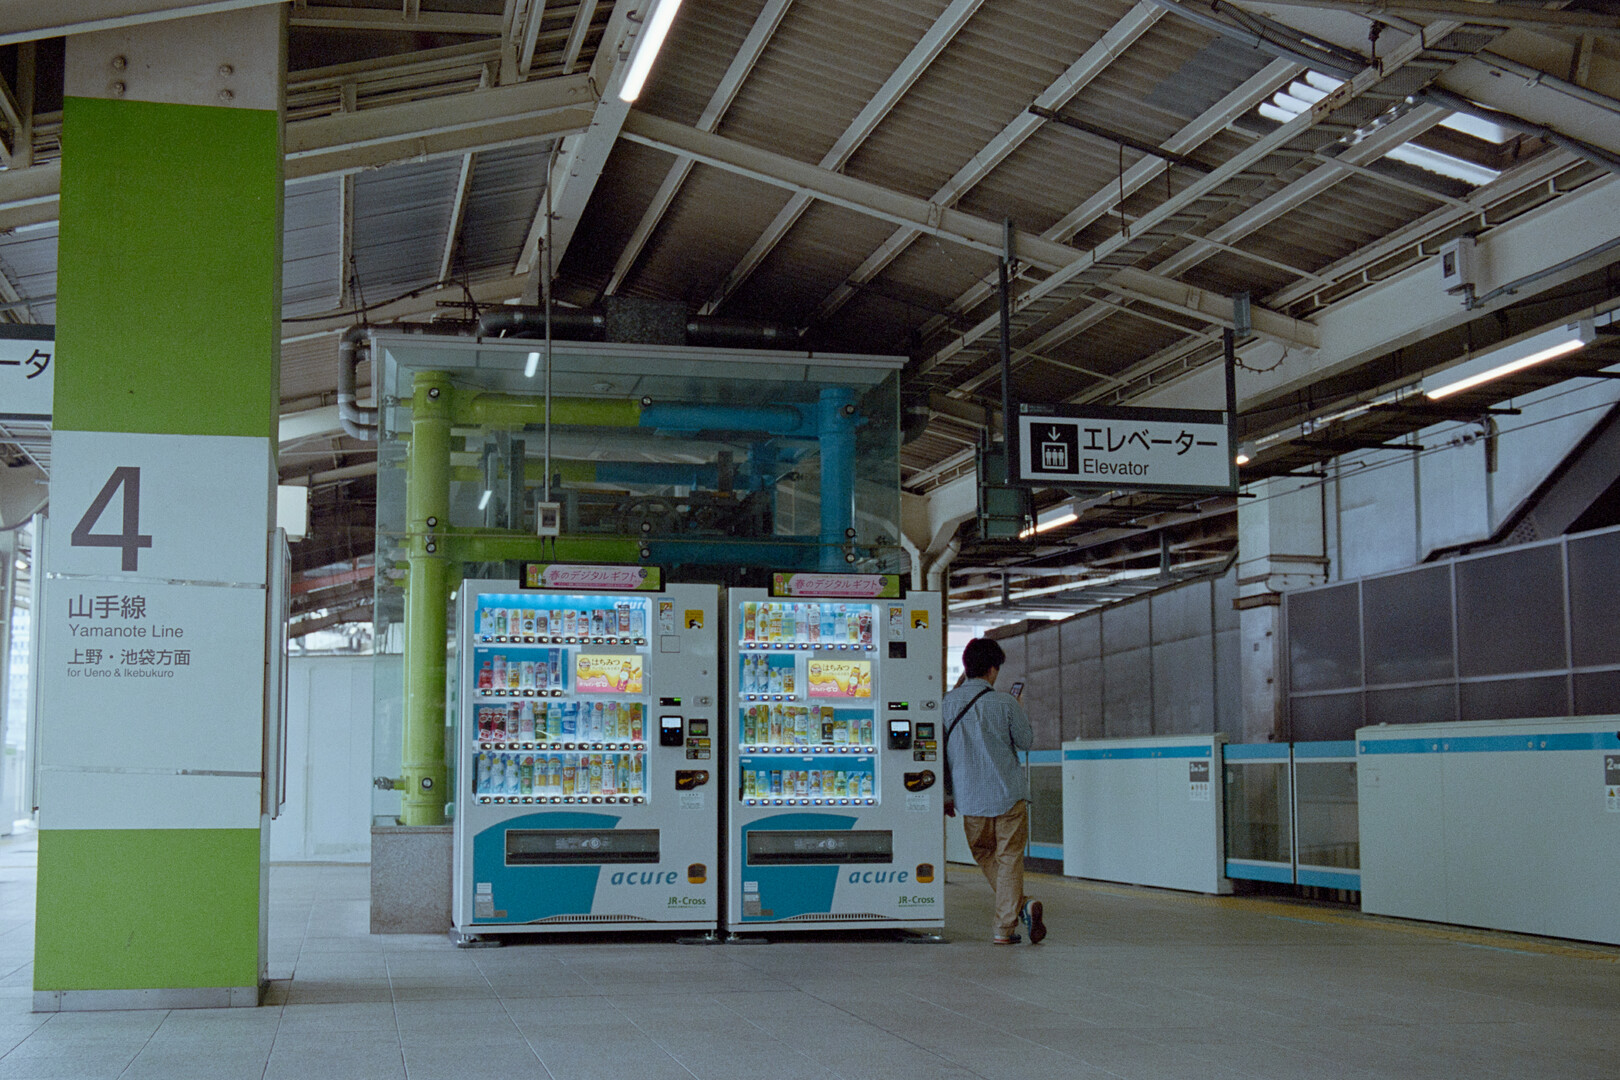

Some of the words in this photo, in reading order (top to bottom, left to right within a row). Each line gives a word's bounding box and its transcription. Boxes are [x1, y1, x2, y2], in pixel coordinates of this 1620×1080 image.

[1083, 427, 1218, 456] エレベーター
[1083, 459, 1149, 476] Elevator
[71, 466, 153, 572] 4
[68, 594, 147, 620] 山手線
[69, 624, 147, 638] Yamanote
[152, 625, 184, 638] Line
[67, 648, 191, 666] 上野・池袋方面
[591, 658, 621, 666] はちみつ
[67, 668, 81, 678] for
[84, 668, 111, 678] Ueno
[113, 669, 121, 678] &
[124, 668, 174, 678] Ikebukuro
[611, 871, 678, 886] acure
[849, 871, 909, 884] acure
